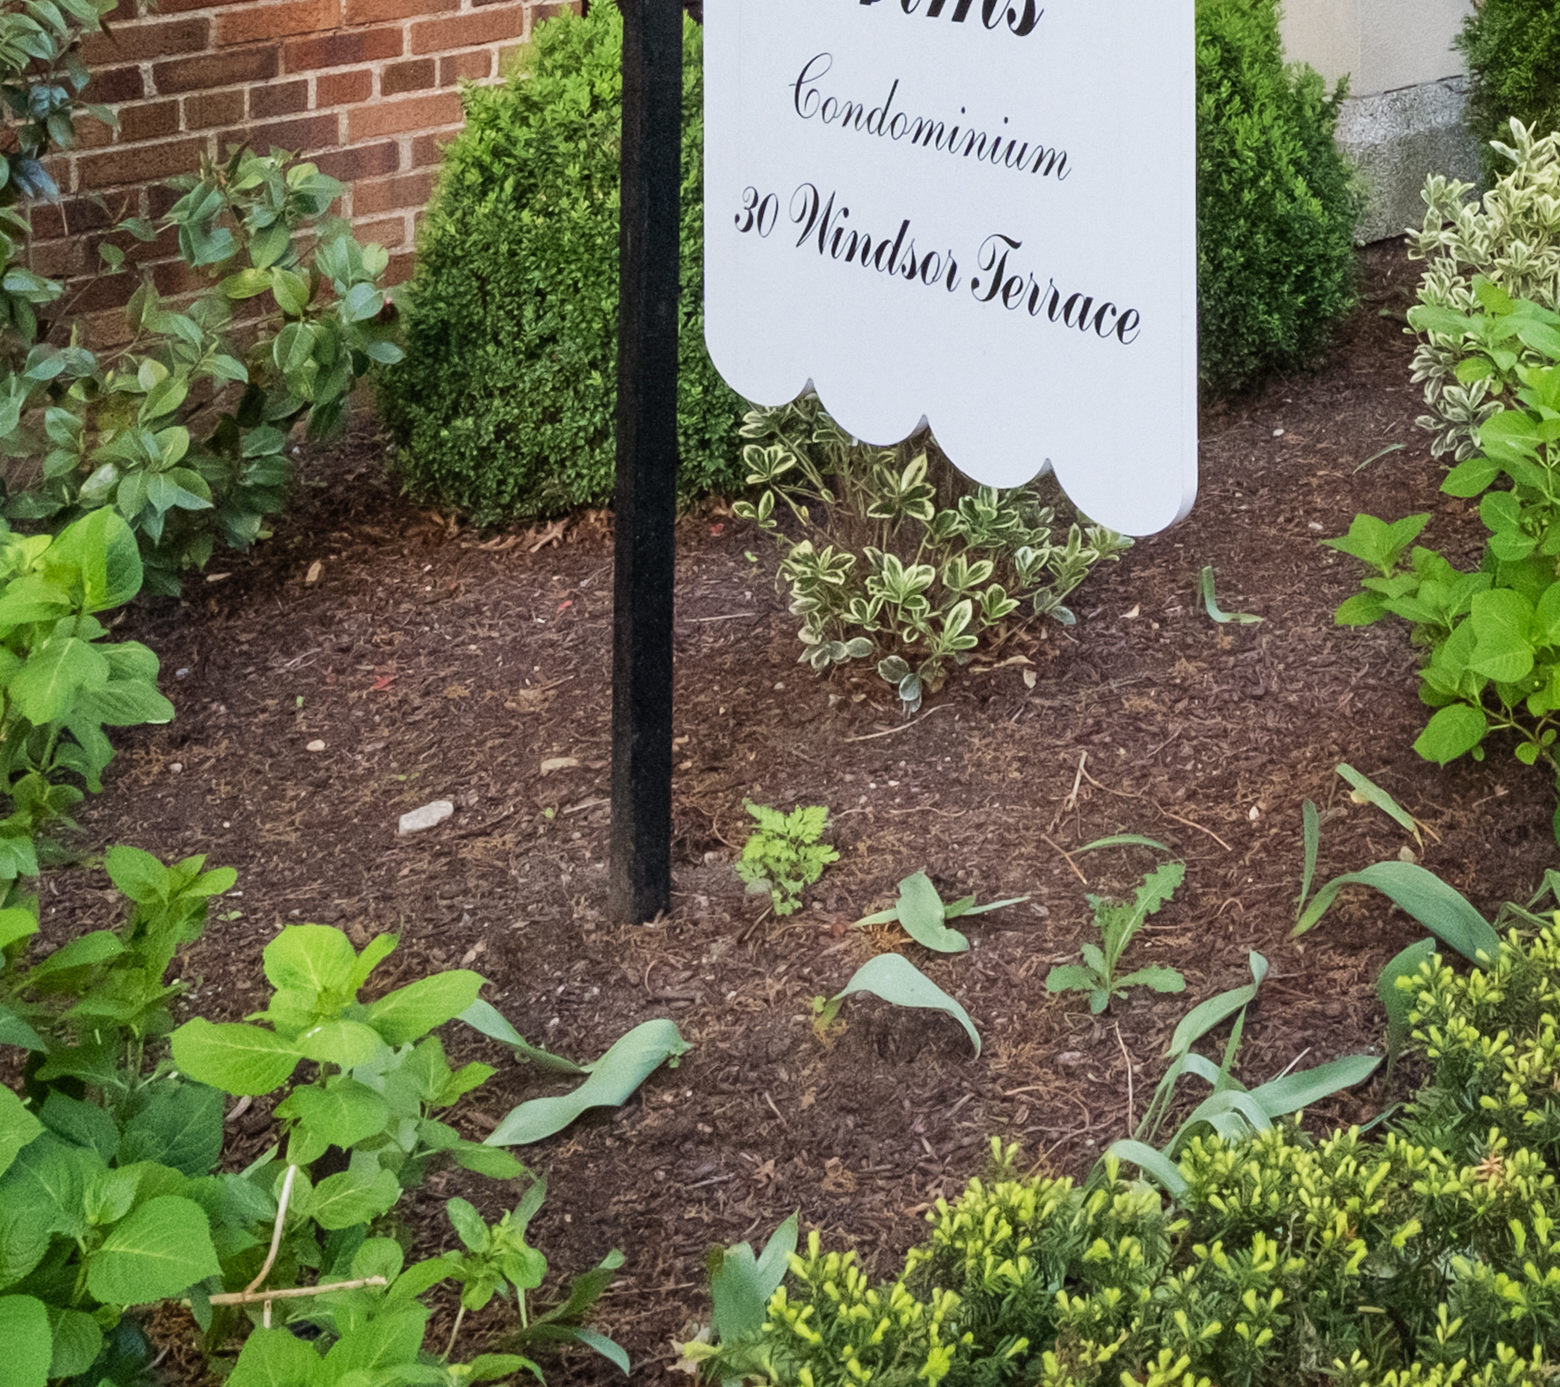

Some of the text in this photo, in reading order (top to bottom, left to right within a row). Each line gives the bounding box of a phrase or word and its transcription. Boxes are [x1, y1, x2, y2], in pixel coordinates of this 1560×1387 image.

[788, 52, 1072, 181] Condominium
[734, 182, 1141, 345] 30 Windsor Terrace
